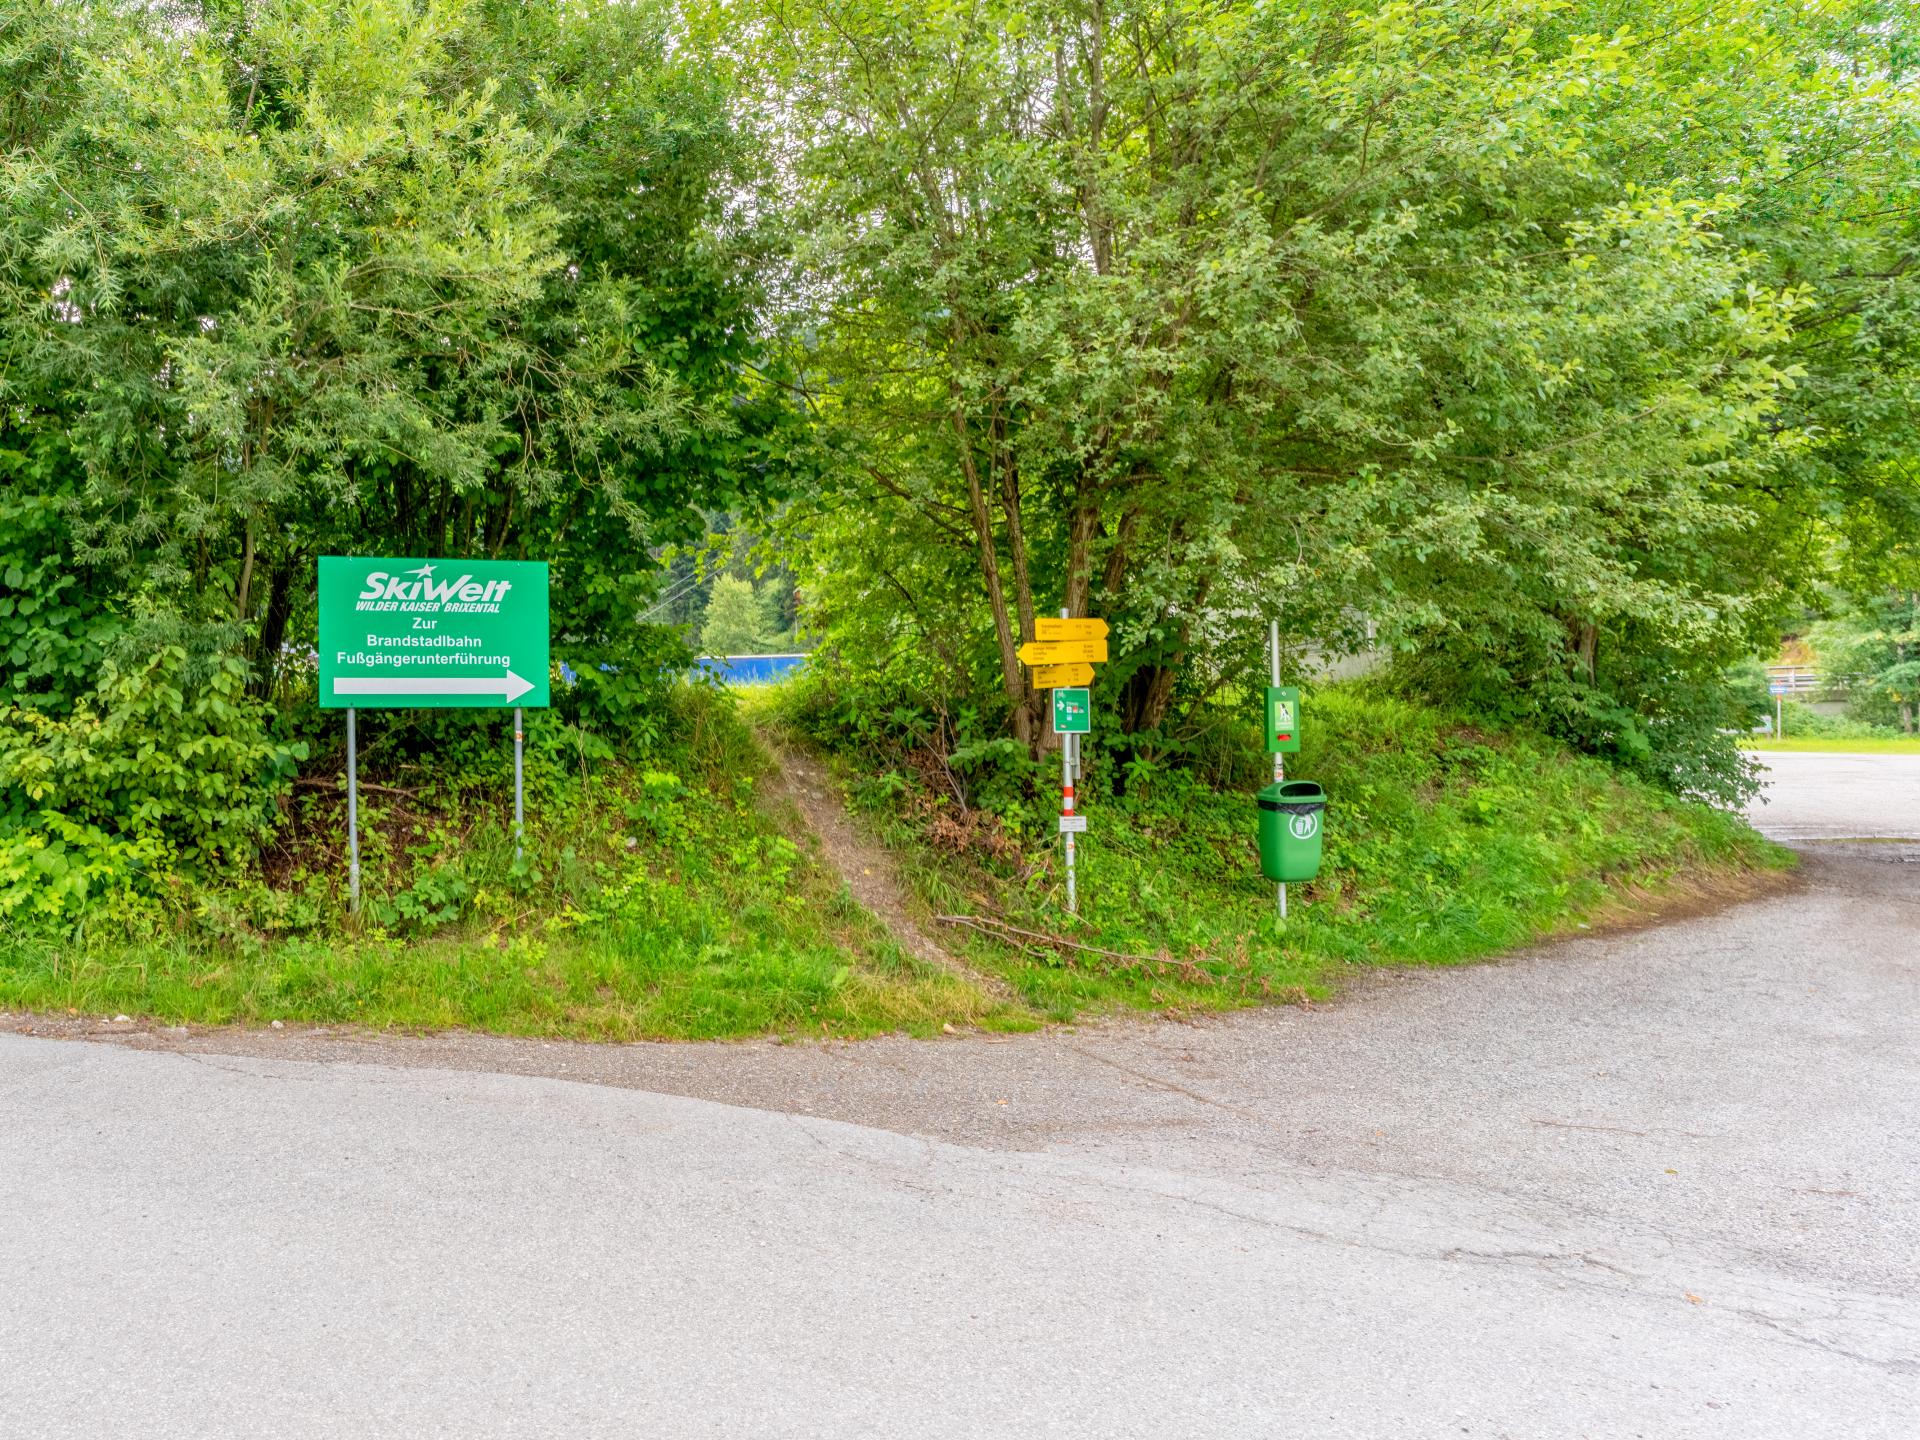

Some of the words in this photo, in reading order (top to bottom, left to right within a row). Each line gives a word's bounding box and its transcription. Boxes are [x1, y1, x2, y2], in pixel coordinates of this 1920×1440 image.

[355, 601, 398, 611] WILDER
[400, 602, 439, 612] KAISER
[444, 603, 500, 613] BRIXENTAL
[412, 617, 438, 630] Zur
[367, 634, 482, 648] Brandstadlbahn
[337, 652, 511, 668] Fußgängerunterführung
